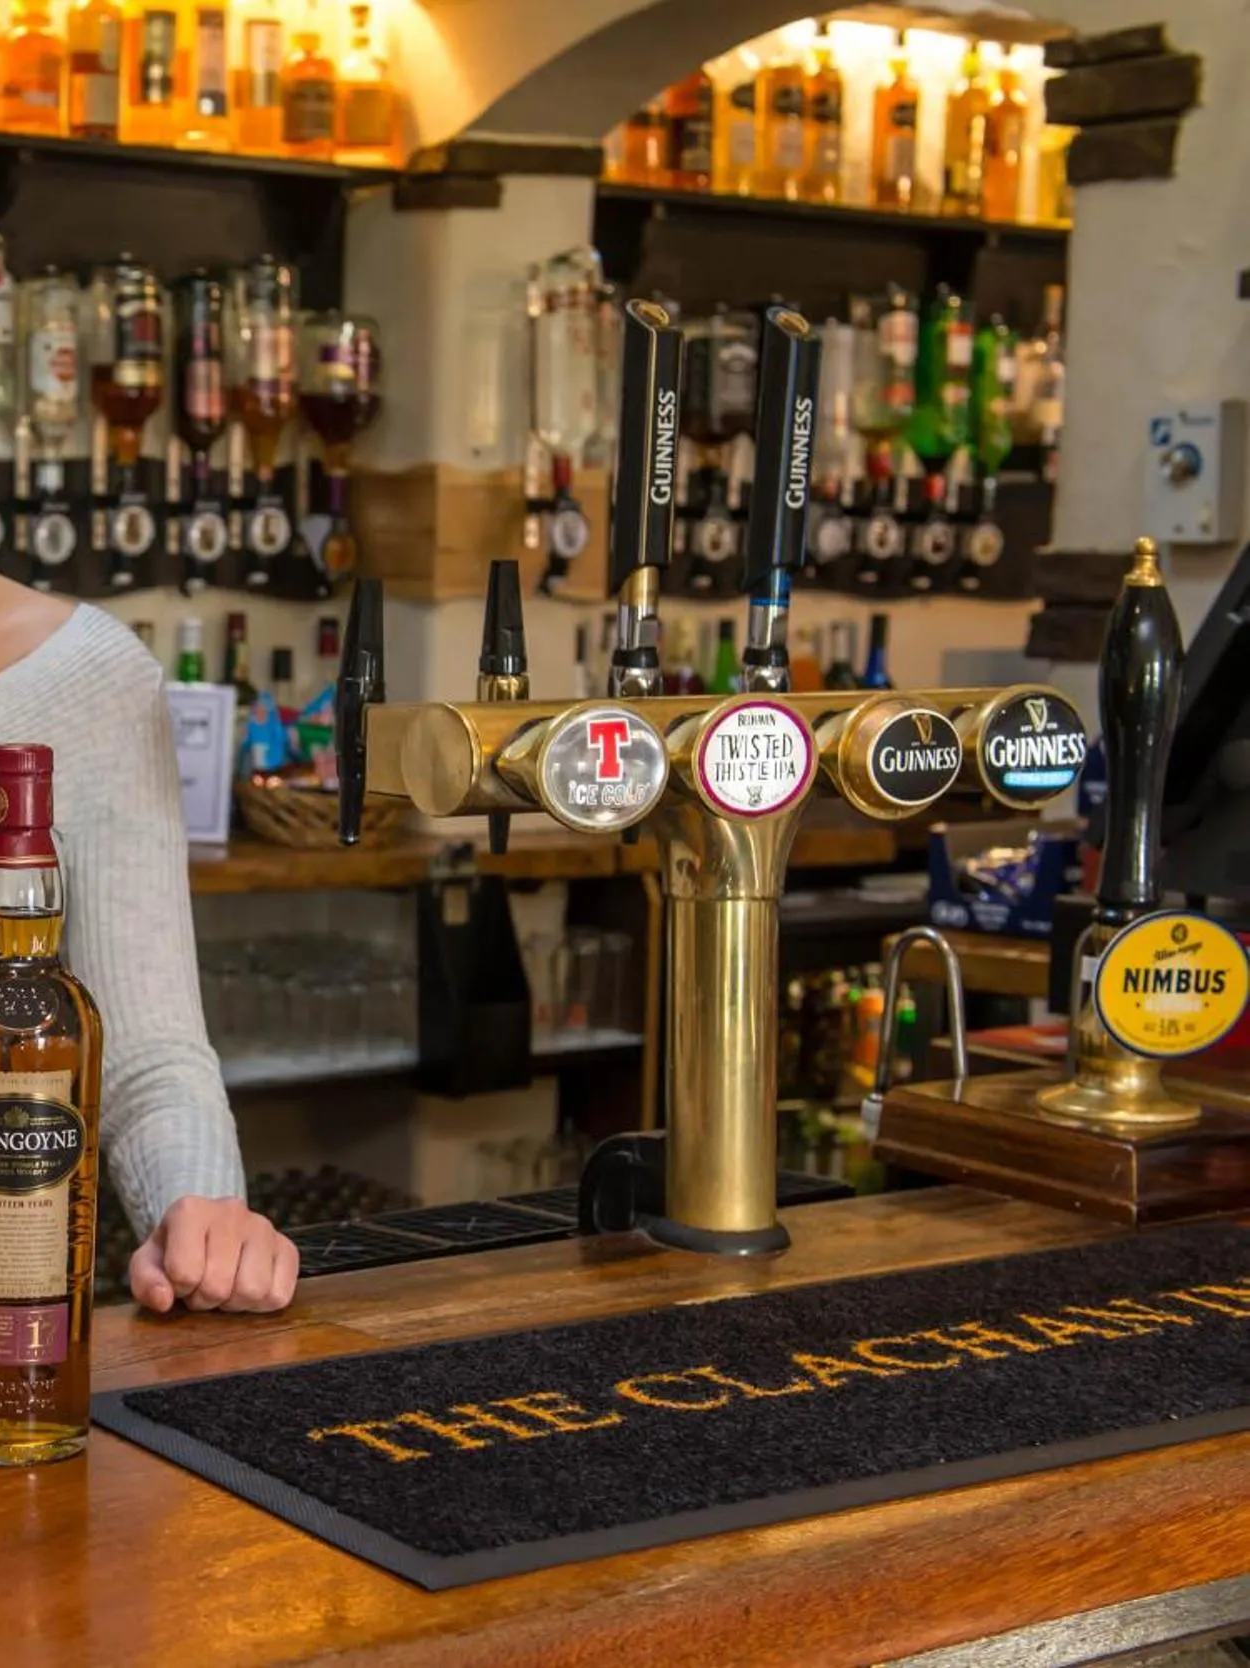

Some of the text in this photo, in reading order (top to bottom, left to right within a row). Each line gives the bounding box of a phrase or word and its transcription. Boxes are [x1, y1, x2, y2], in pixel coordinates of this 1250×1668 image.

[650, 387, 676, 504] GUINNESS
[785, 394, 813, 509] GUINNESS
[587, 718, 631, 782] T
[716, 734, 793, 760] TWISTED
[879, 746, 958, 773] GUINNESS
[988, 733, 1086, 769] GUINNESS
[714, 759, 796, 783] THISTLE IPA
[1123, 967, 1227, 994] NIMBUS
[306, 1391, 626, 1464] THE
[614, 1297, 1195, 1413] CLACHAN
